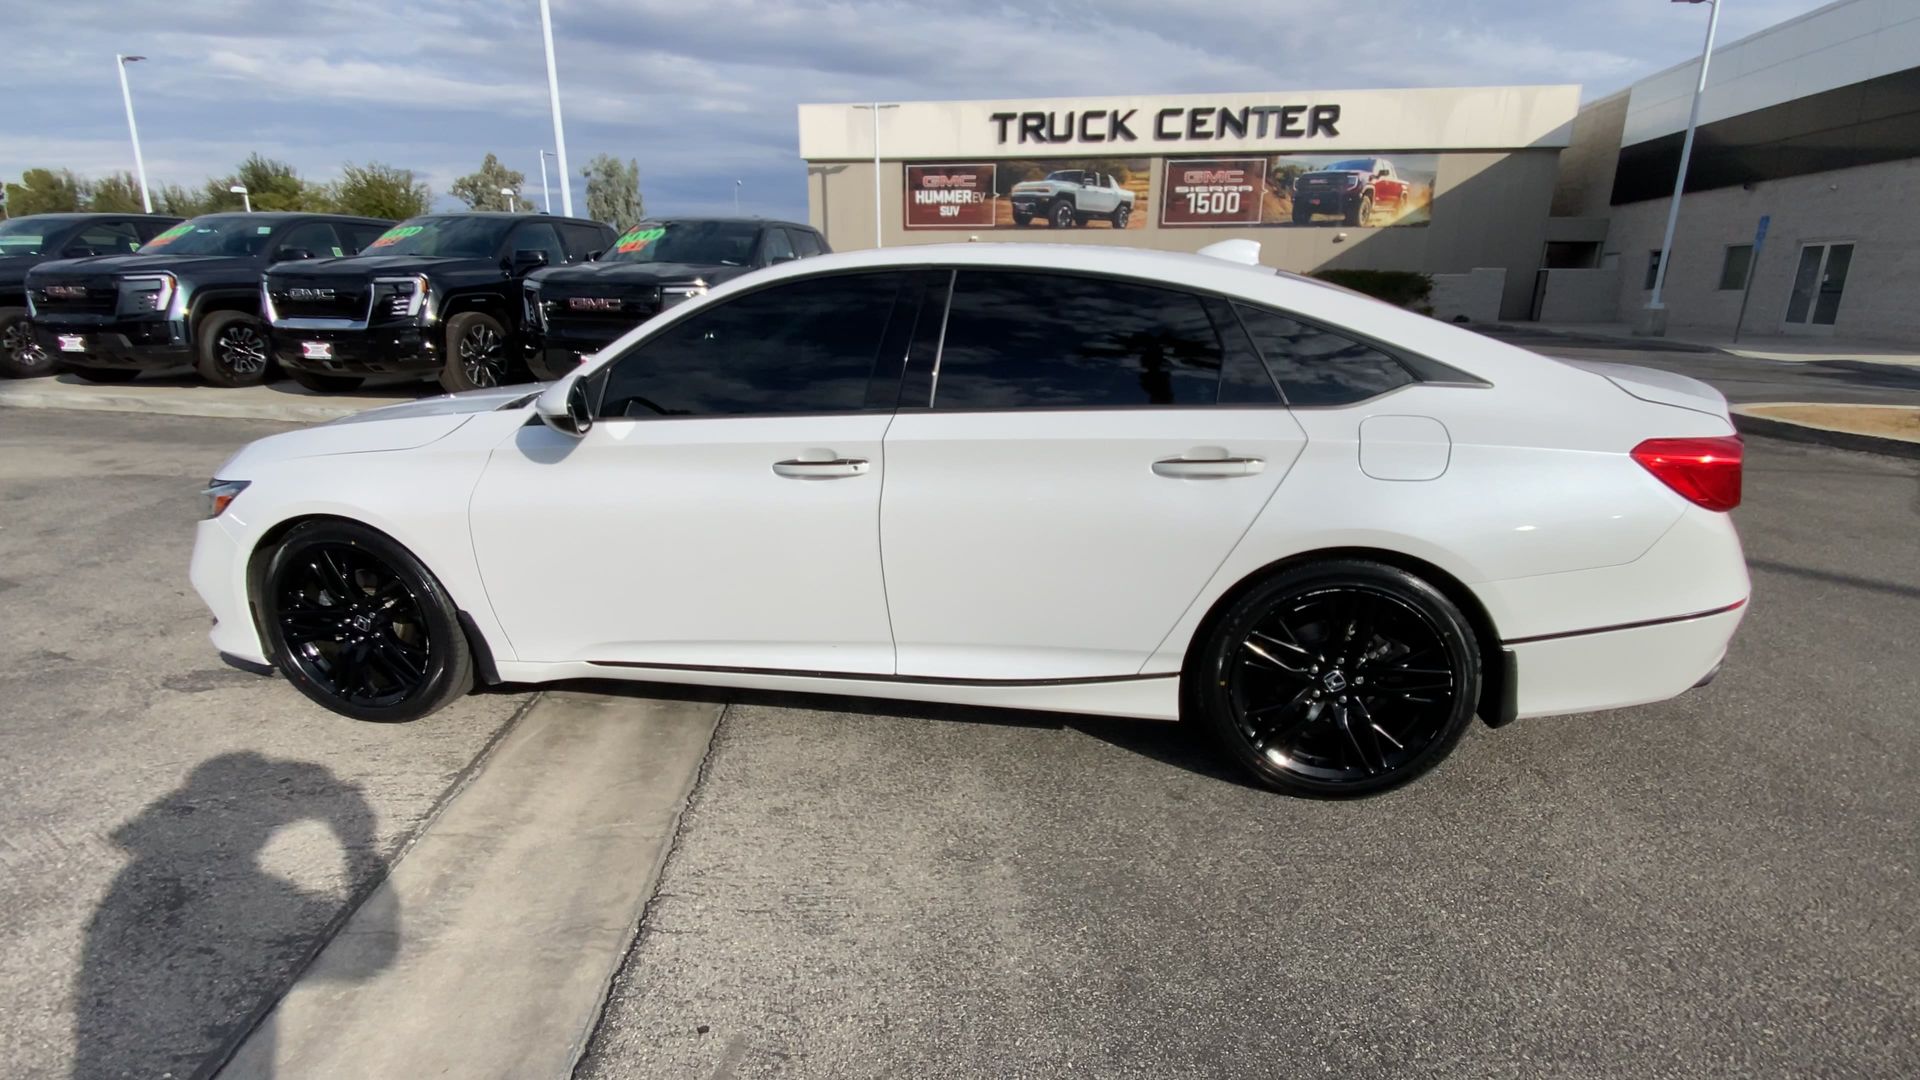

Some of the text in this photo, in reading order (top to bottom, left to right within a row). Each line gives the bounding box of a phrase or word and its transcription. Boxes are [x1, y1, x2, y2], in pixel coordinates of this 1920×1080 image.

[990, 104, 1341, 144] TRUCK CENTER
[922, 175, 977, 187] GMC
[1184, 170, 1244, 183] GMC
[915, 190, 972, 204] HUMMER
[1186, 192, 1240, 214] 1500
[940, 205, 960, 217] SUV
[290, 288, 335, 300] GMC
[569, 297, 621, 310] GMC
